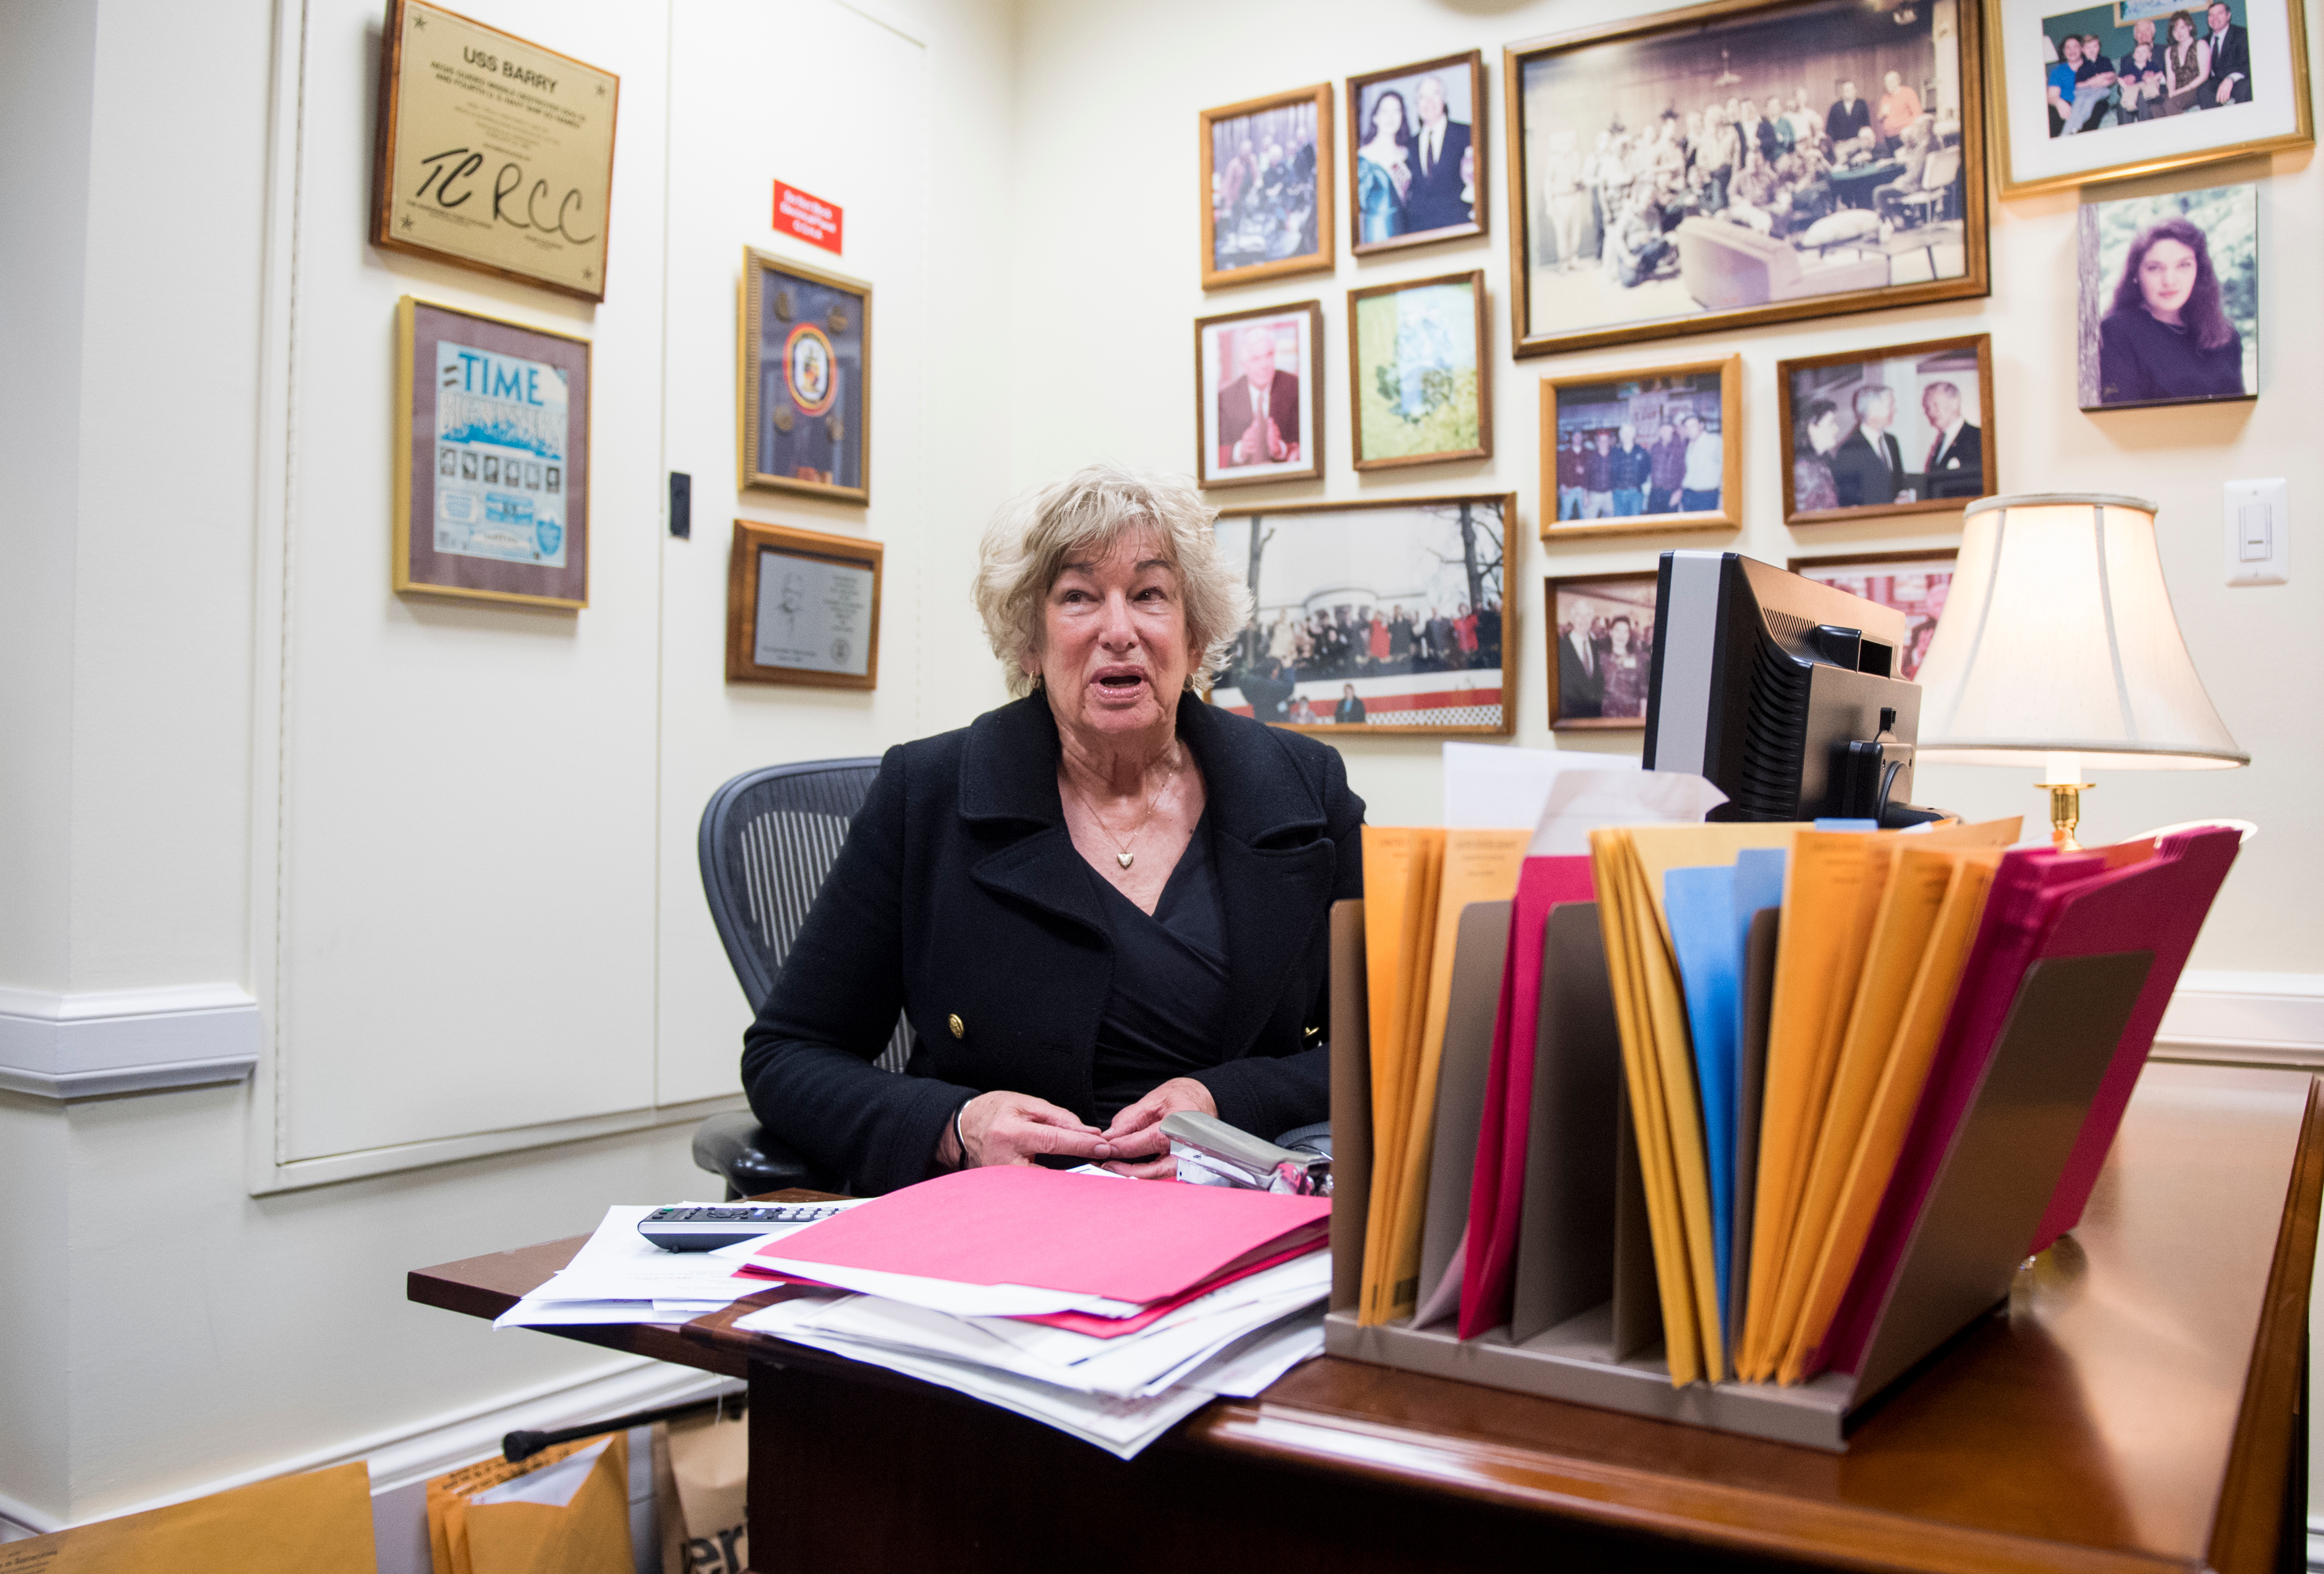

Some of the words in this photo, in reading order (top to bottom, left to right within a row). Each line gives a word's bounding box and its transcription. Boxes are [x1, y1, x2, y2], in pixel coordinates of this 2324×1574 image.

[463, 46, 498, 73] USS
[501, 61, 559, 94] BARRY
[458, 351, 545, 406] TIME
